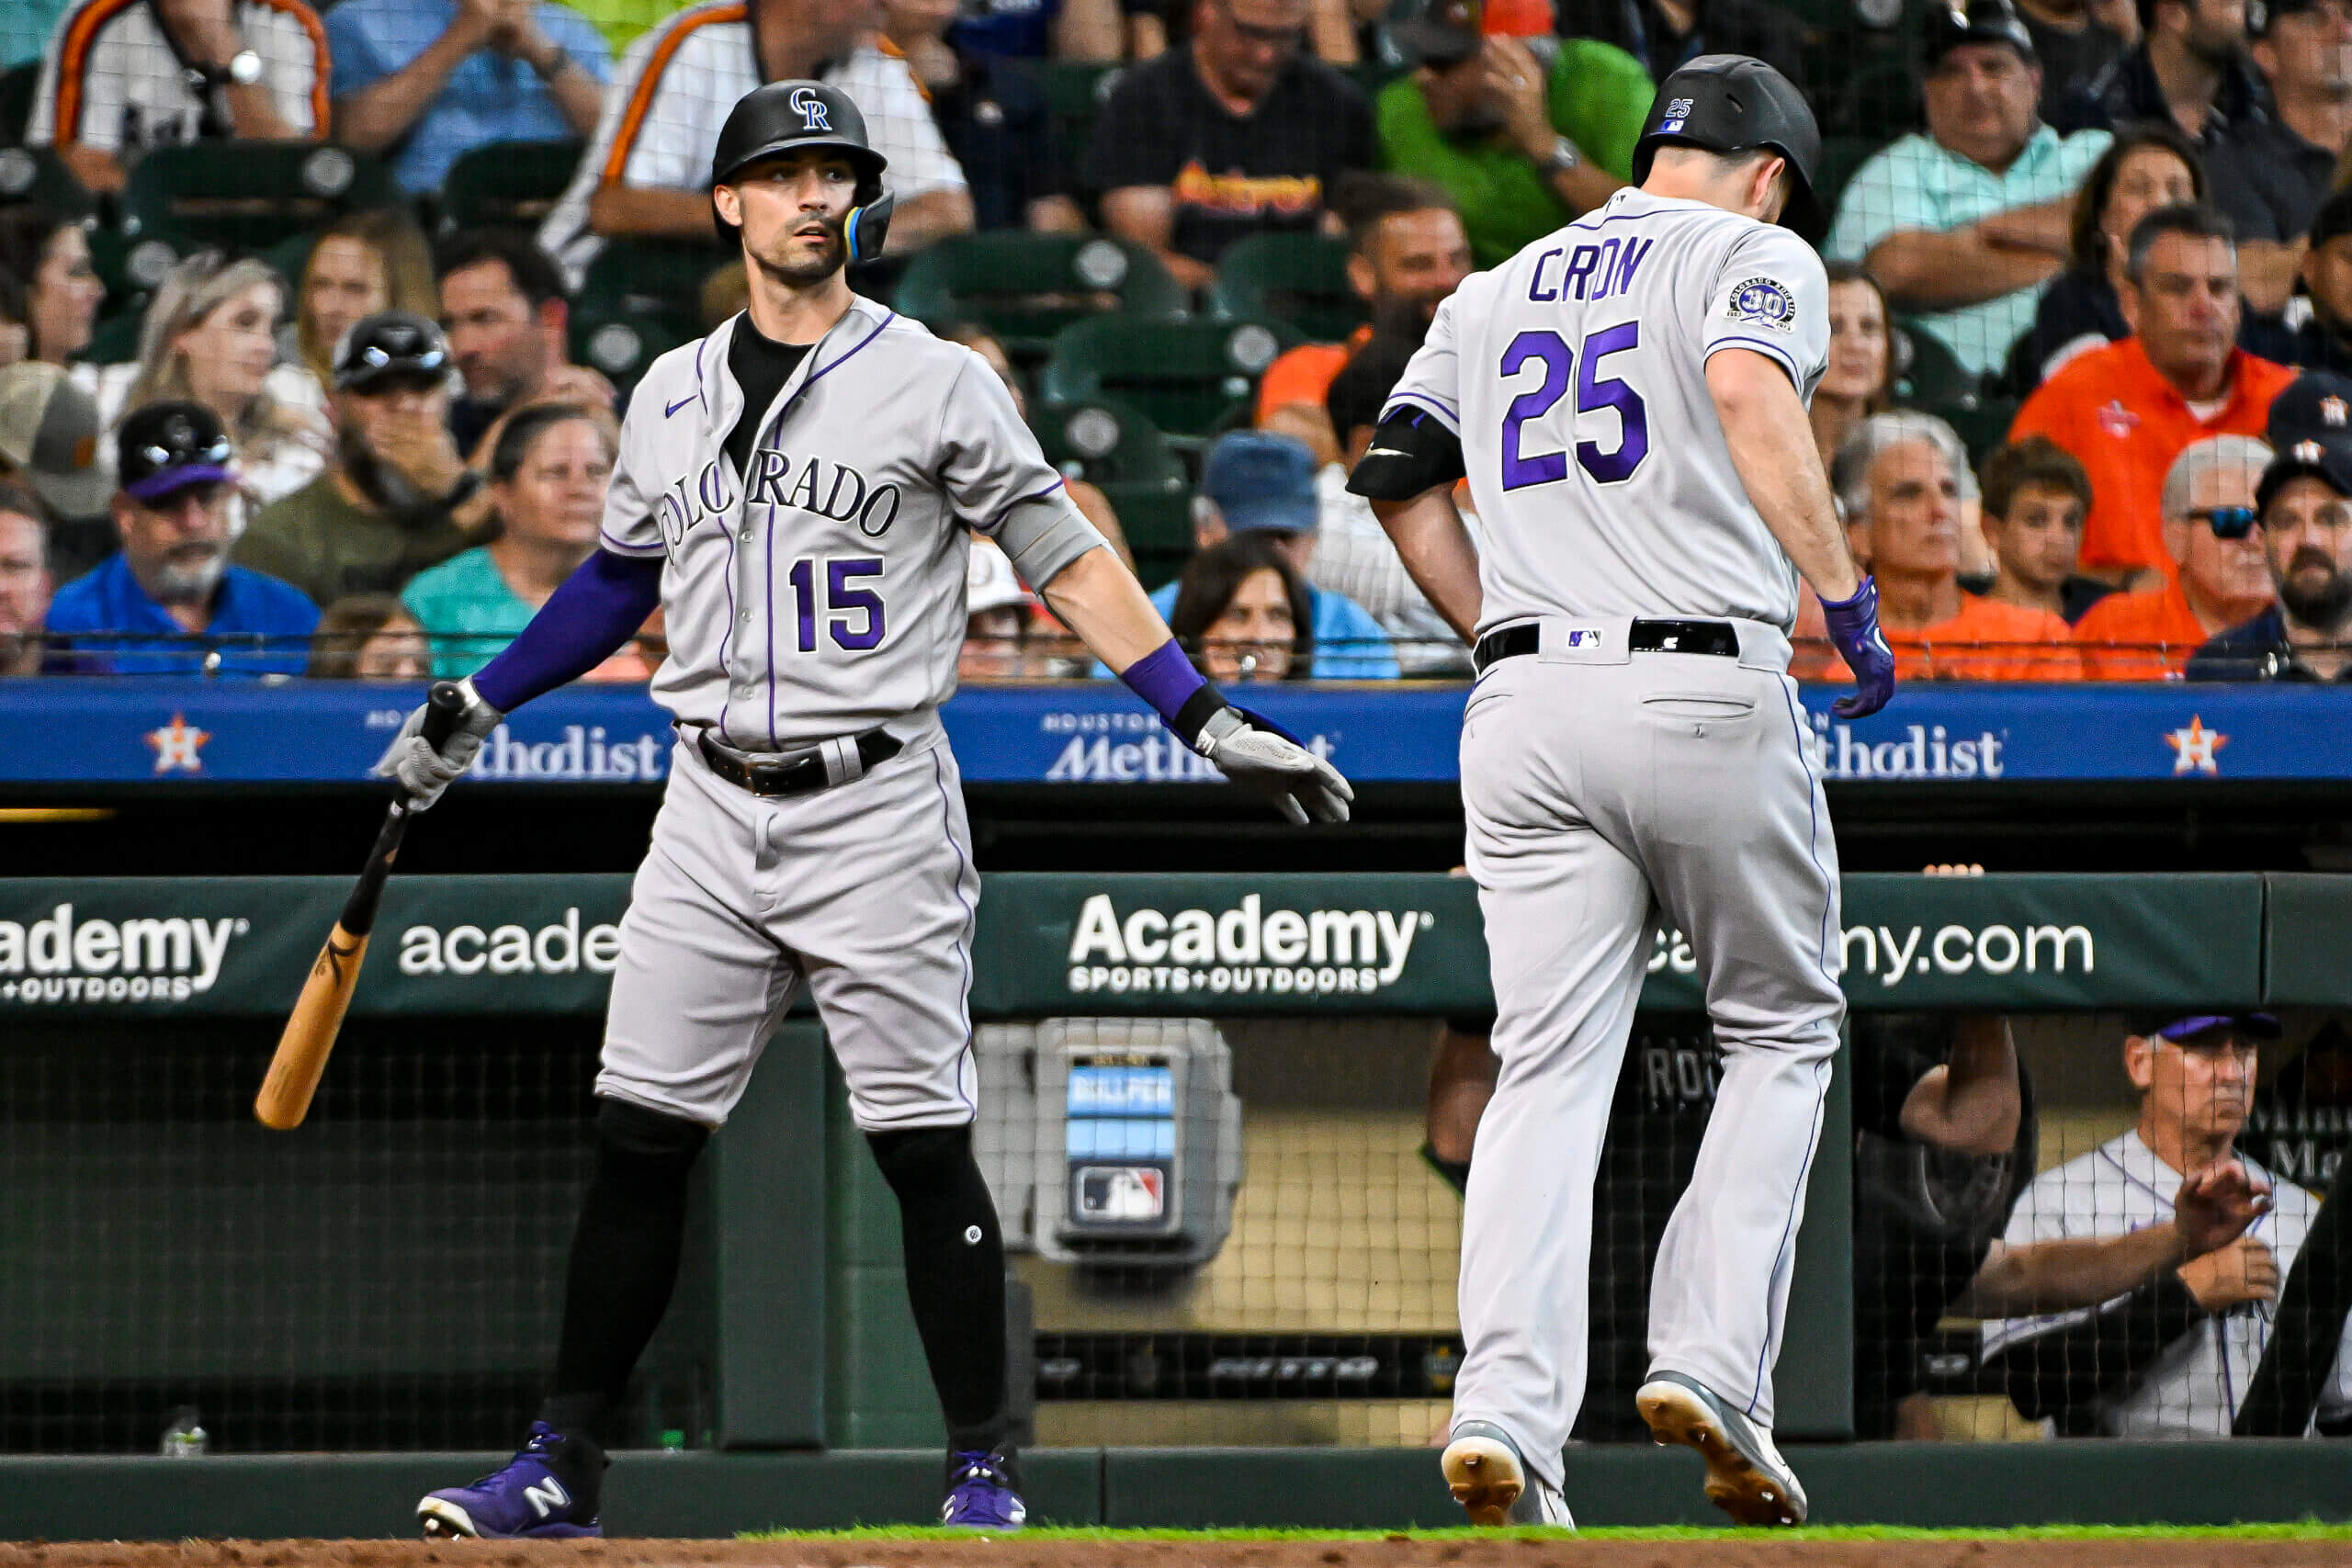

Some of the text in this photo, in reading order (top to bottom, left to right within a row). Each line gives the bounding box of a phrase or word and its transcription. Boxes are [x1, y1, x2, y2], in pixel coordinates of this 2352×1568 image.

[790, 87, 833, 131] CR
[1665, 97, 1694, 118] 25
[1529, 236, 1654, 301] CRON
[1499, 319, 1650, 492] 25
[787, 556, 888, 653] 15
[469, 723, 663, 779] thodist
[1815, 724, 2004, 778] thodist
[0, 903, 232, 992] ademy
[1069, 893, 1419, 985] Academy
